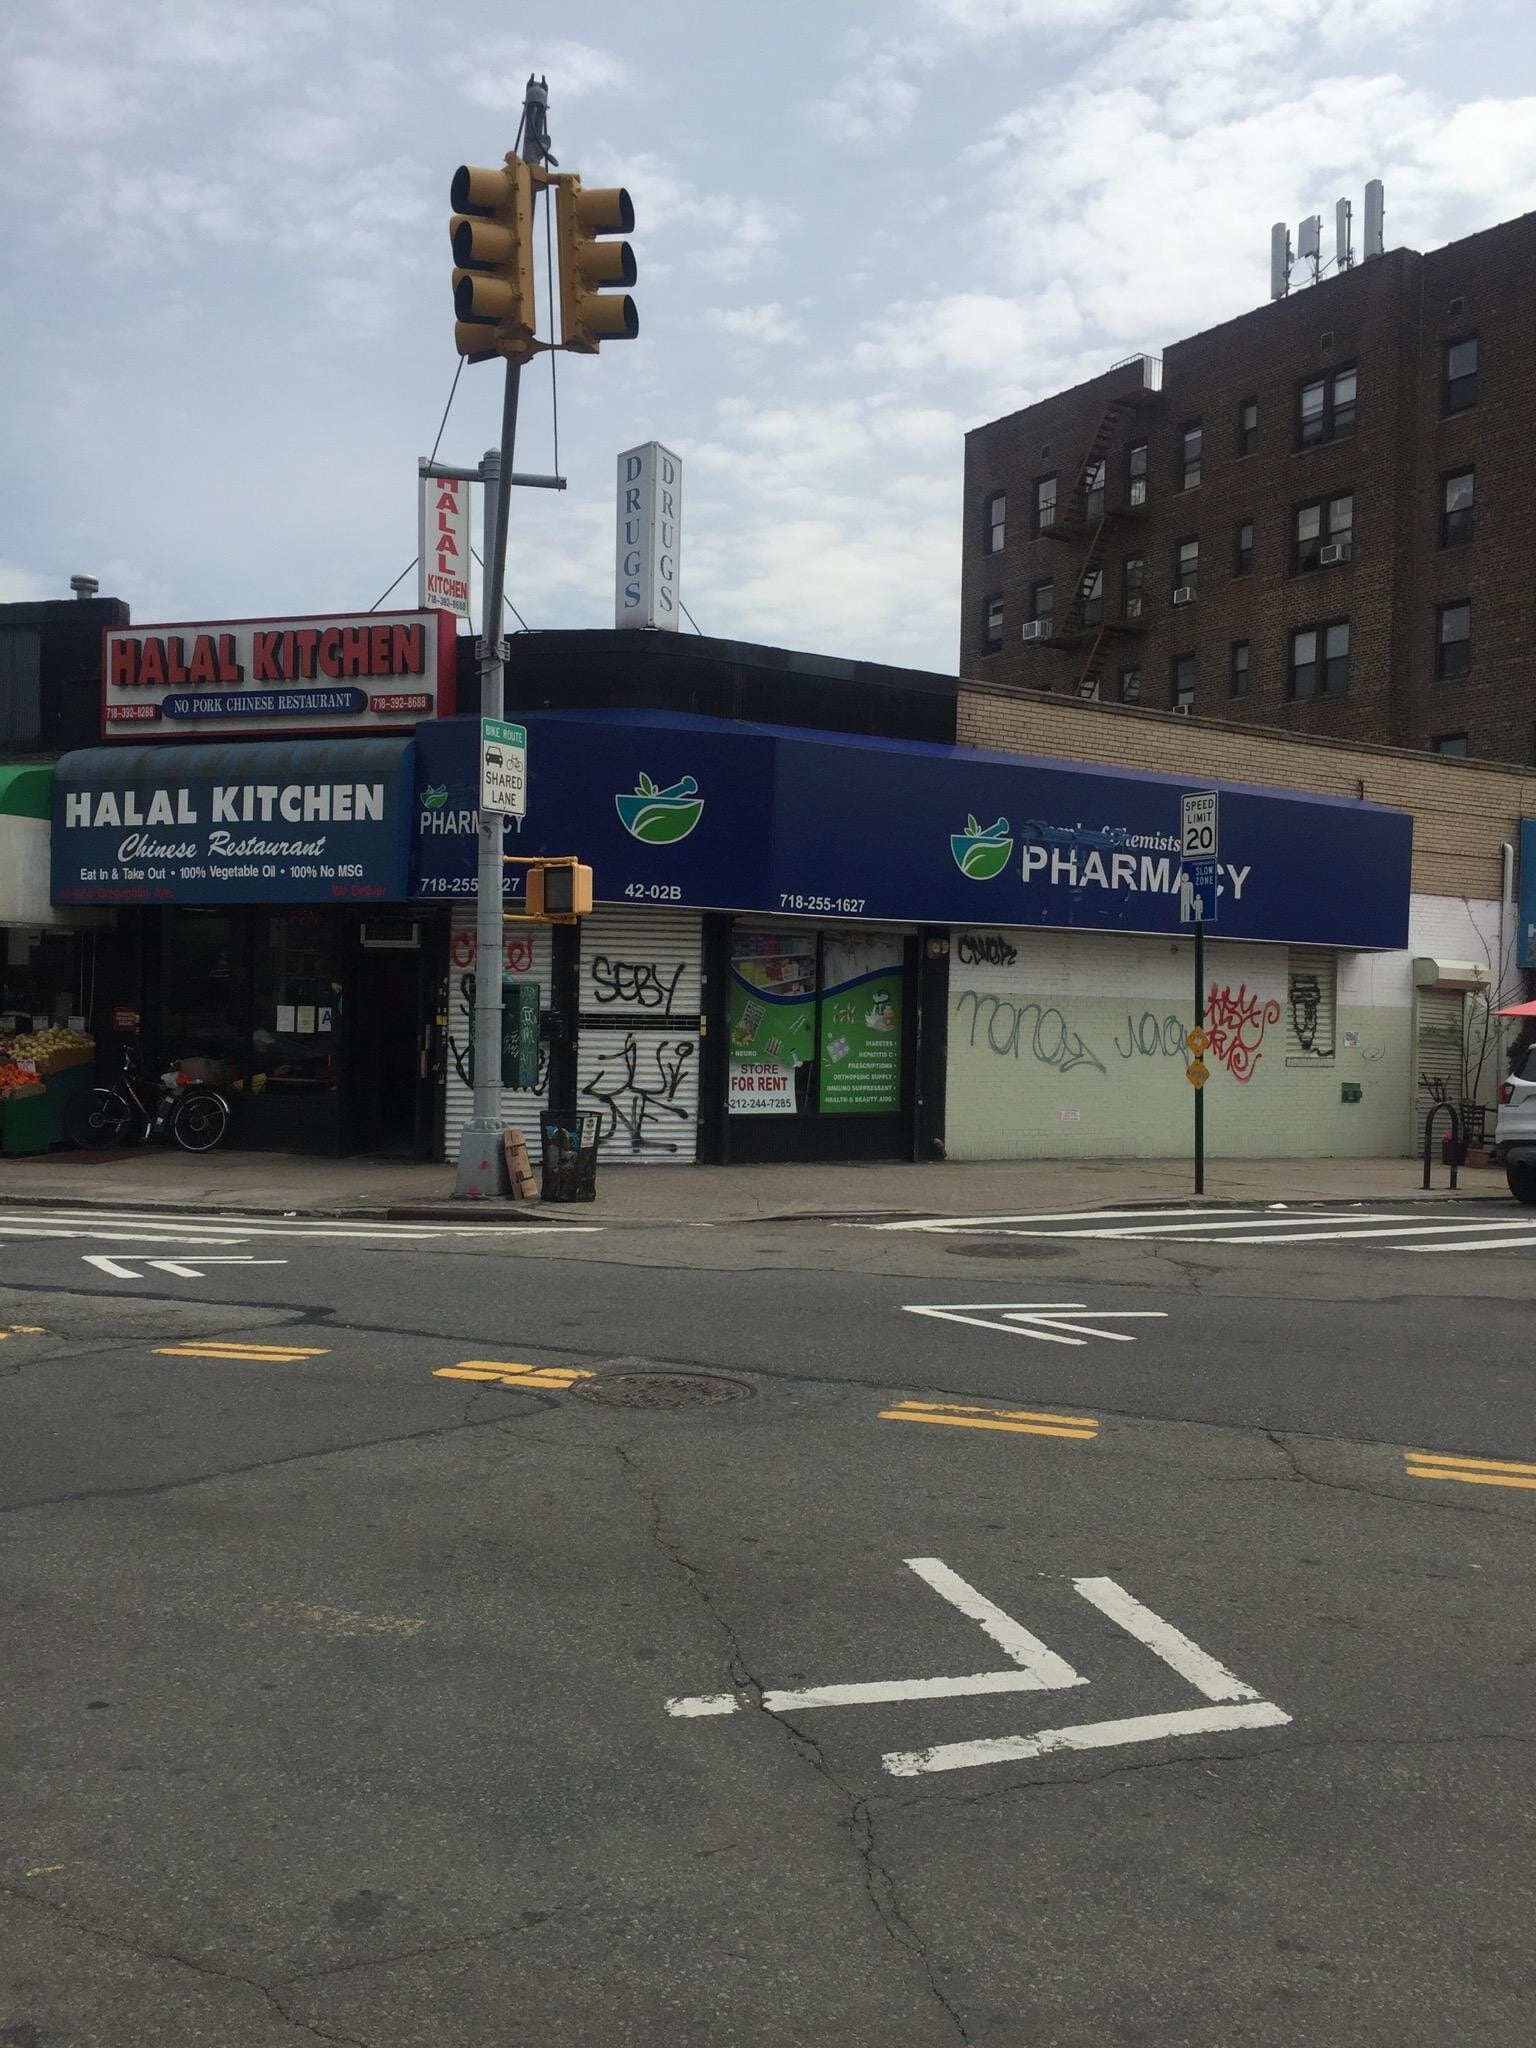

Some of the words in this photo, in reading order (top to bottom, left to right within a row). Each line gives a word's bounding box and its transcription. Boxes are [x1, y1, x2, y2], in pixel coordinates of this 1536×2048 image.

[436, 478, 459, 575] HALAL
[623, 456, 642, 608] DRUGS
[659, 457, 674, 612] DRUGS
[428, 574, 466, 600] KITCHEN
[111, 633, 244, 686] HALAL
[253, 623, 425, 680] KITCHEN
[174, 699, 189, 713] NO
[193, 698, 223, 713] PORK
[226, 696, 275, 711] CHINESE
[278, 693, 352, 710] RESTAURANT
[485, 725, 500, 738] BIKE
[503, 728, 523, 744] ROUTE
[485, 771, 523, 790] SHARED
[66, 788, 197, 828] HALAL
[212, 784, 384, 823] KITCHEN
[492, 790, 516, 807] LANE
[1186, 799, 1214, 811] SPEED
[420, 811, 523, 834] PHARMCY
[1188, 812, 1212, 824] LIMIT
[117, 833, 197, 863] Chinese
[208, 830, 326, 857] Restaurant
[1186, 826, 1213, 850] 20
[80, 868, 97, 880] Eat
[100, 868, 108, 880] In
[111, 868, 119, 880] &
[122, 867, 144, 880] Take
[148, 867, 166, 880] Out
[180, 866, 206, 879] 100%
[210, 865, 259, 880] Vegetable
[262, 865, 276, 878] Oil
[290, 865, 317, 878] 100%
[320, 865, 335, 878] No
[338, 864, 363, 878] MSG
[1022, 845, 1251, 900] PHARMY
[1195, 866, 1214, 876] SLOW
[420, 878, 520, 892] 718-25527
[1195, 876, 1214, 886] ZONE
[624, 884, 682, 900] 42-02B
[780, 894, 866, 913] 718-255-1627
[741, 1064, 779, 1075] STORE
[731, 1077, 754, 1091] FOR
[758, 1077, 788, 1091] RENT
[730, 1099, 792, 1109] 212-244-7285
